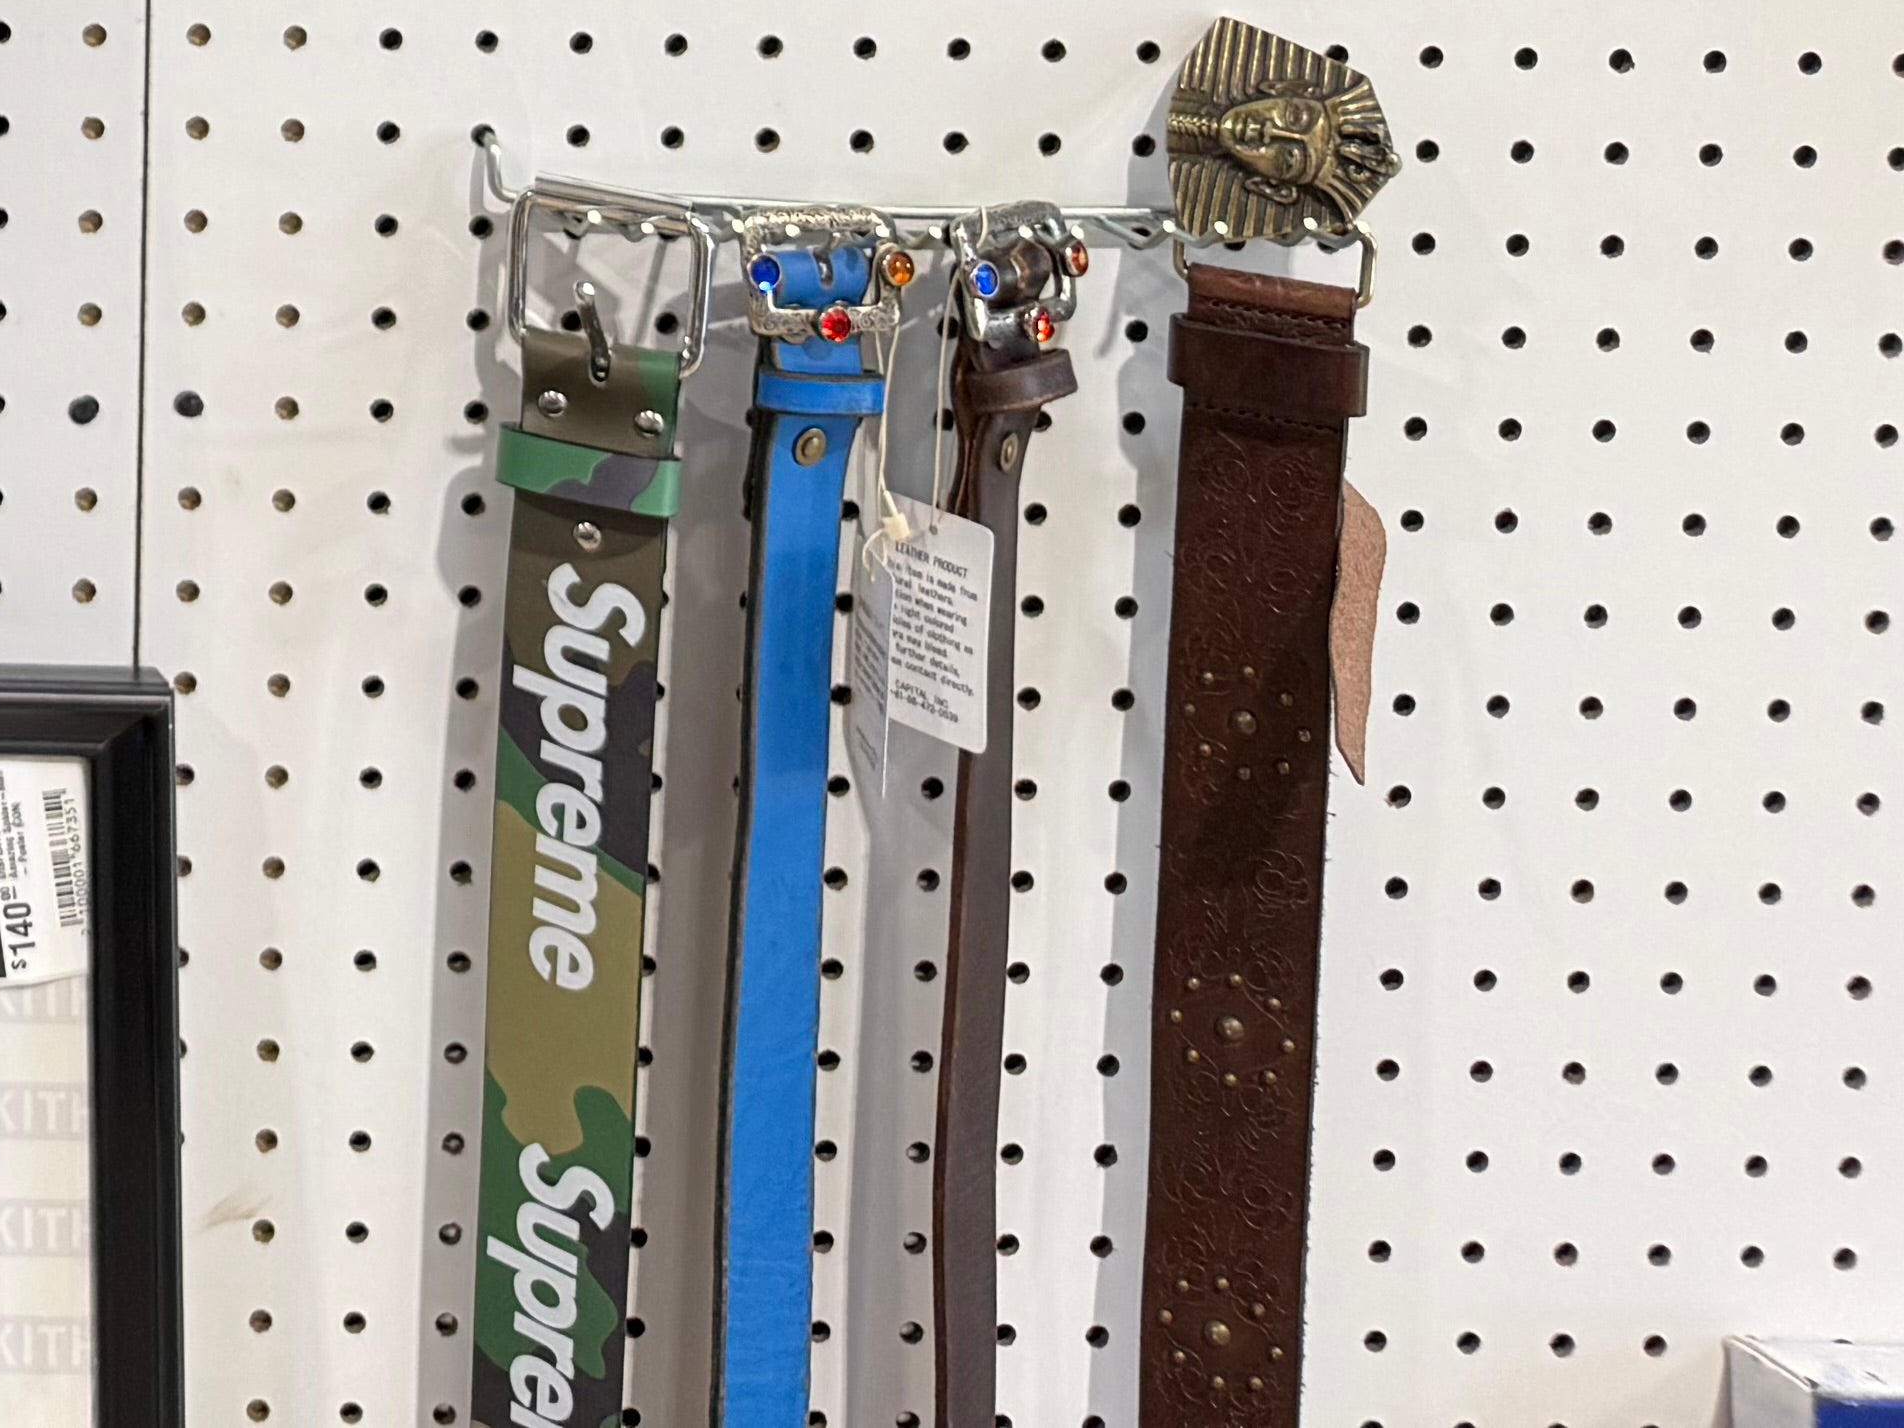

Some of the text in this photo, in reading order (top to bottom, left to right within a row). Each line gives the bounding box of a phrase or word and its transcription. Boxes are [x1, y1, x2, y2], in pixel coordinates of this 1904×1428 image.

[895, 540, 968, 578] LEATHER PRODUCT
[512, 561, 646, 992] Supreme
[487, 1142, 616, 1428] Supre
